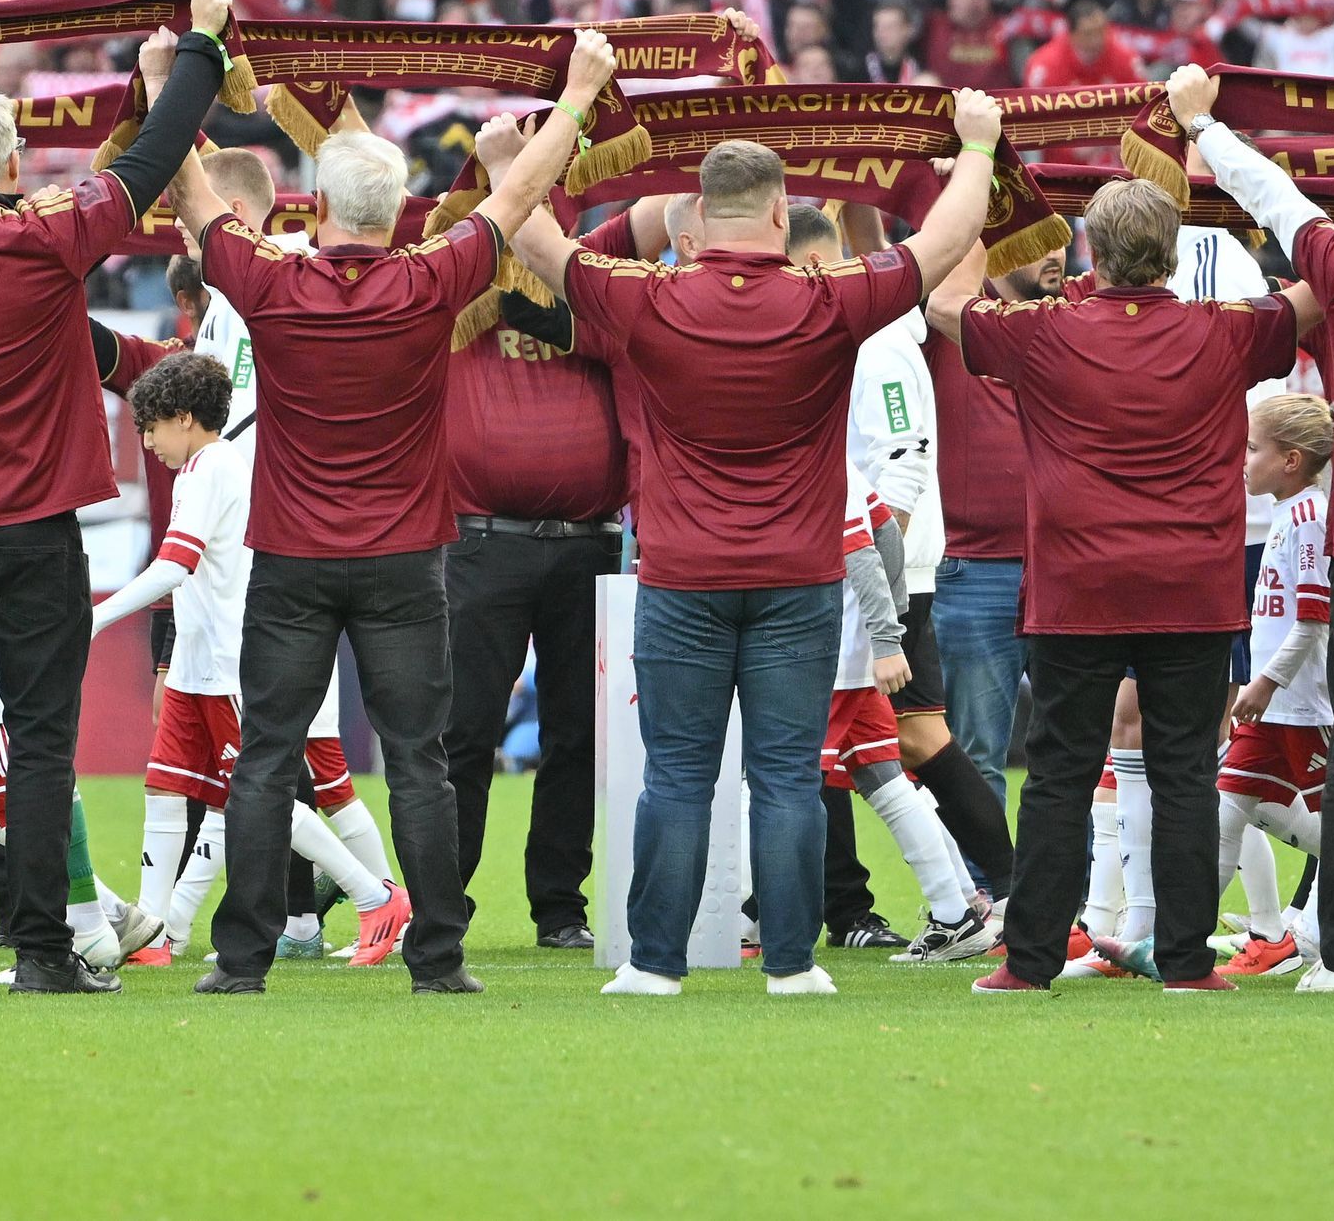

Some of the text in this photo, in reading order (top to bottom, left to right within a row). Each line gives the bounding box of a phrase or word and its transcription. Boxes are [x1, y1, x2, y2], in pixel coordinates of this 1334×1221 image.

[743, 92, 851, 114] NACH
[1030, 89, 1118, 113] NACH
[886, 386, 906, 430] DEVK
[1299, 543, 1307, 572] CLUB
